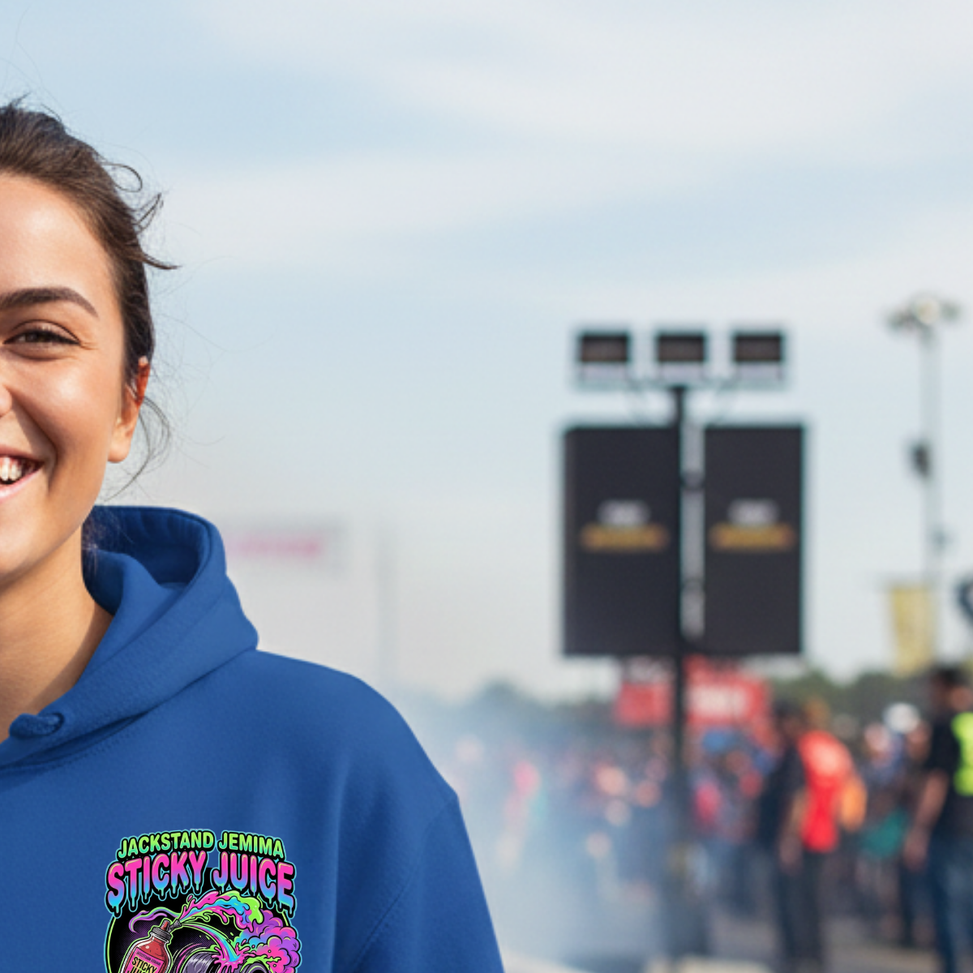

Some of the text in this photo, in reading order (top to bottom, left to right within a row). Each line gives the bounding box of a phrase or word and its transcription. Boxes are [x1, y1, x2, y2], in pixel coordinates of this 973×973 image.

[118, 831, 284, 859] JACKSTAND JEMIMA
[108, 850, 294, 914] STICKY JUICE
